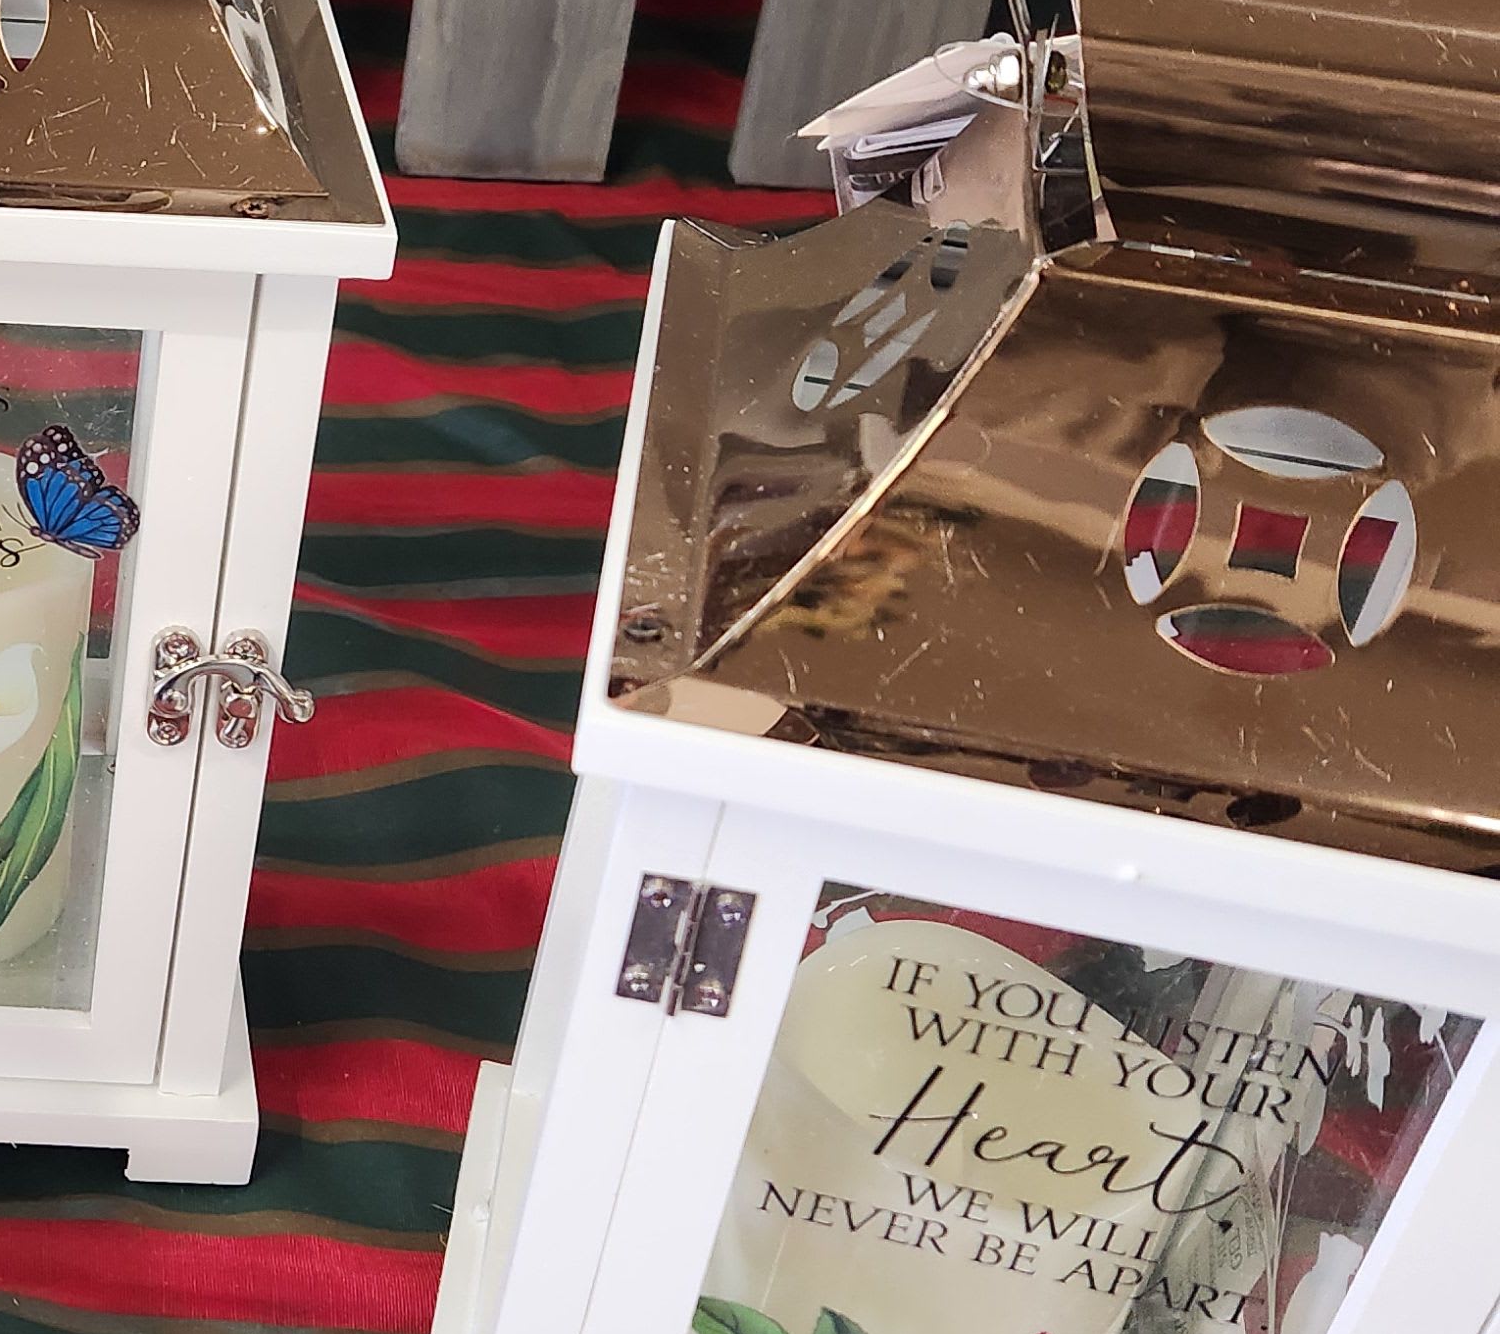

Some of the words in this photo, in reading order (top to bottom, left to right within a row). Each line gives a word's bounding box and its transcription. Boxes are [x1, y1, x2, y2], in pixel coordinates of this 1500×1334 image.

[881, 955, 942, 996] IF
[966, 971, 1095, 1034] YOU
[1114, 1009, 1344, 1087] LISTEN
[903, 1005, 1082, 1077] WITH
[1112, 1050, 1294, 1124] YOUR
[759, 1179, 949, 1255] NEVER
[975, 1237, 1043, 1275] BE
[901, 1172, 996, 1224] WE
[1017, 1198, 1163, 1264] WILL
